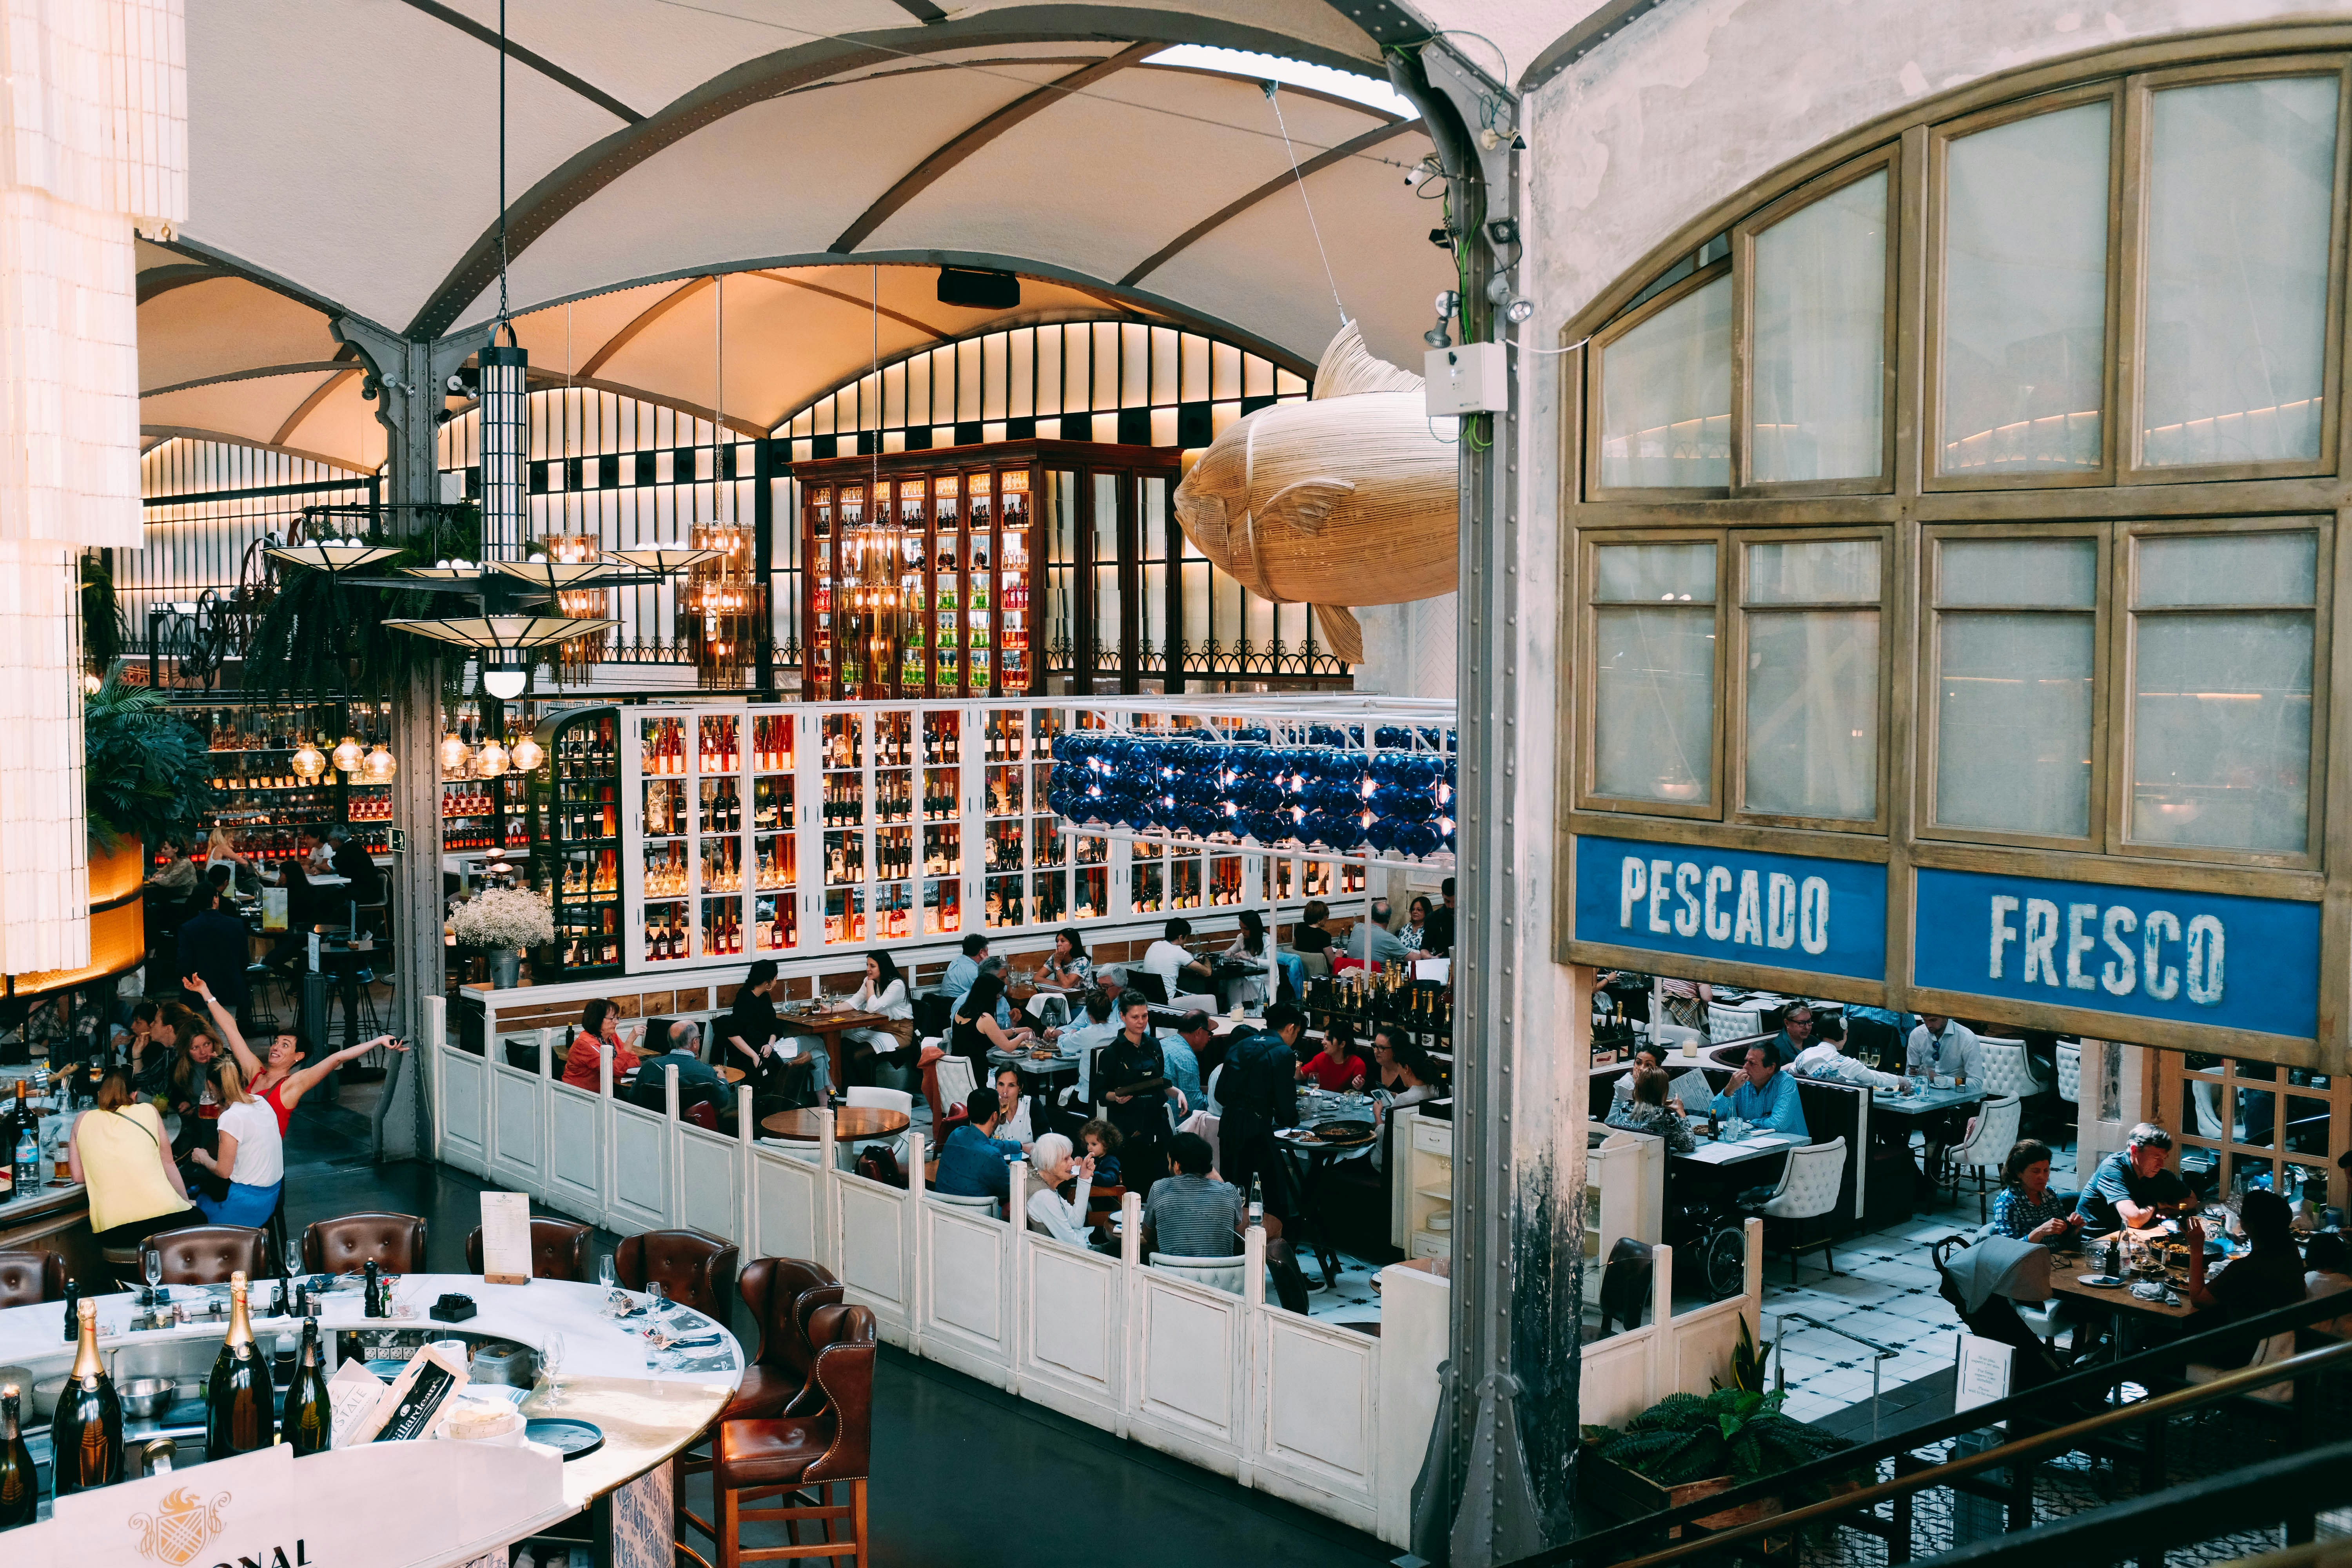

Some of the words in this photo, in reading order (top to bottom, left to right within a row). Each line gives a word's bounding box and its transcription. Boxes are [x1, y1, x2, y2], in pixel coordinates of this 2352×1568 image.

[1621, 856, 1829, 955] PESCADO
[1989, 895, 2225, 1007] FRESCO
[332, 1388, 367, 1433] YSTALE
[392, 1381, 438, 1440] illardeau
